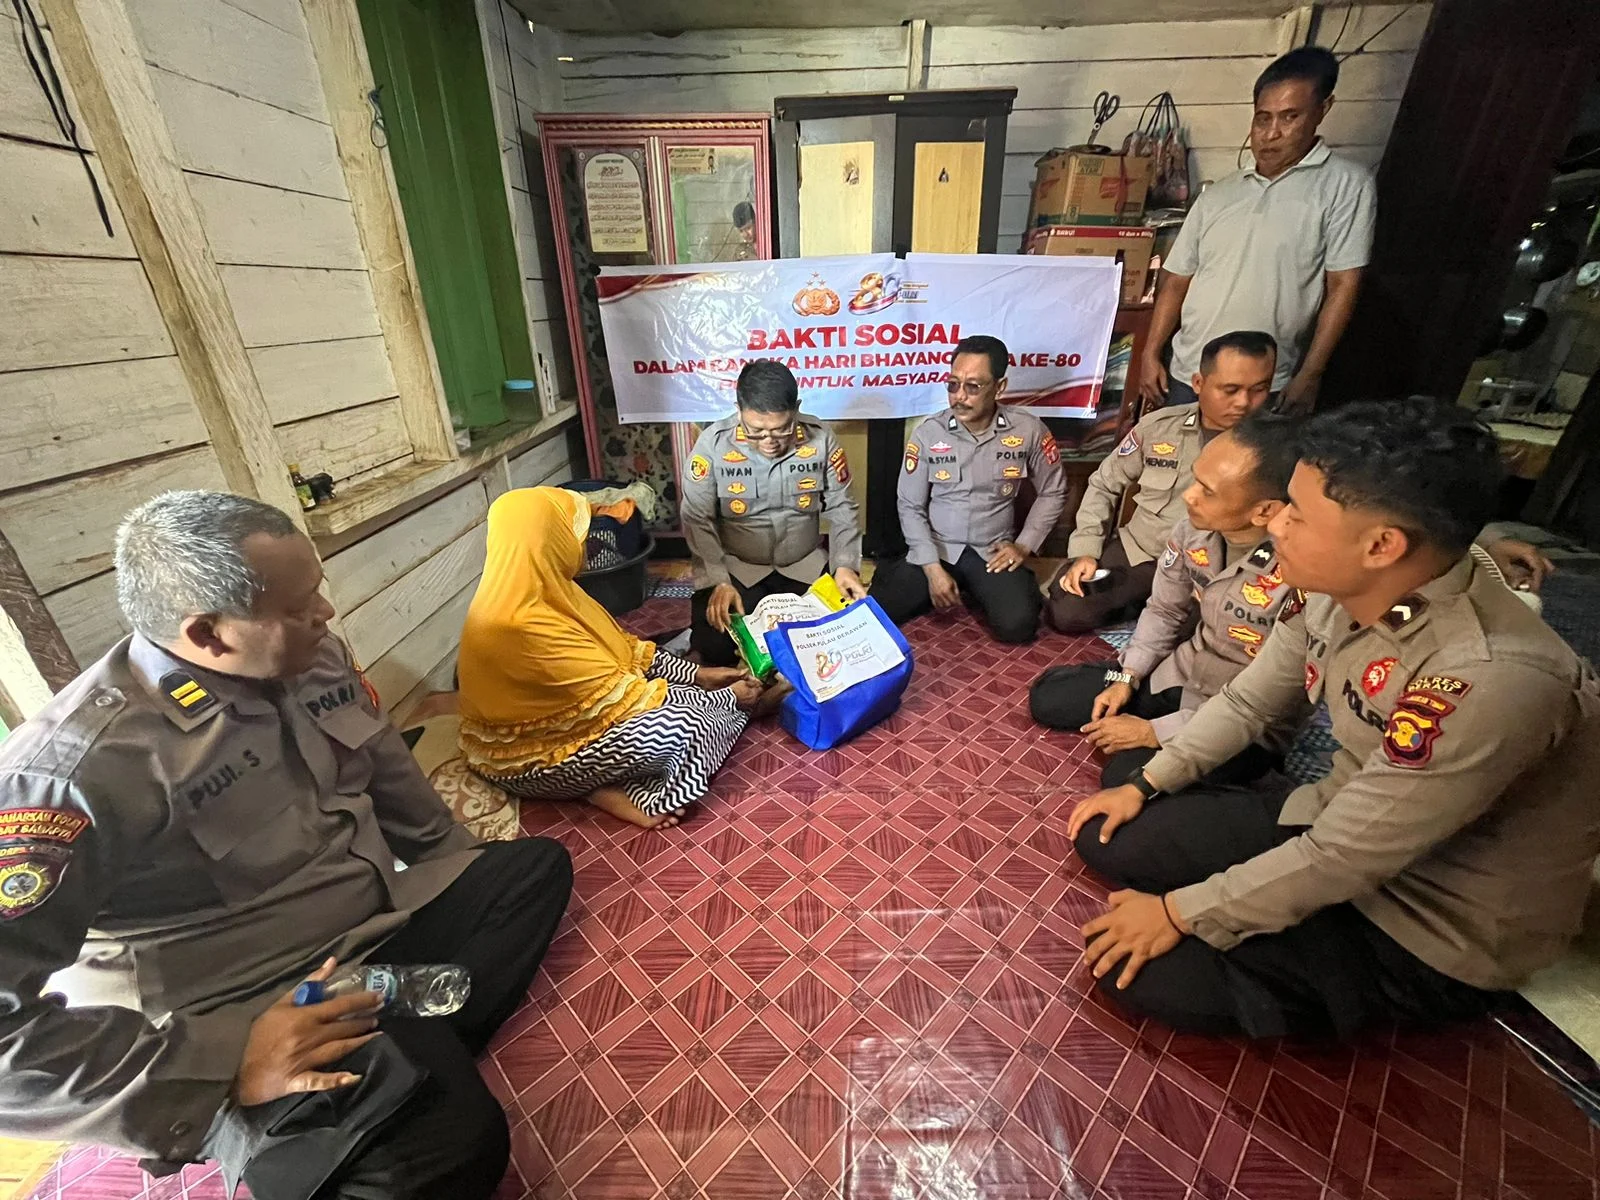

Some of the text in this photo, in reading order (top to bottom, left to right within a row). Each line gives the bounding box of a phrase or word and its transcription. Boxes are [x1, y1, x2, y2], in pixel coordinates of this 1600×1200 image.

[746, 323, 962, 351] BAKTI SOSIAL
[633, 358, 706, 374] DALAM
[804, 354, 856, 369] HARI
[1020, 353, 1081, 368] KE-80
[996, 451, 1028, 461] POLRI
[721, 466, 752, 477] IWAN
[789, 462, 823, 473] POLRI
[306, 683, 356, 718] POLRI
